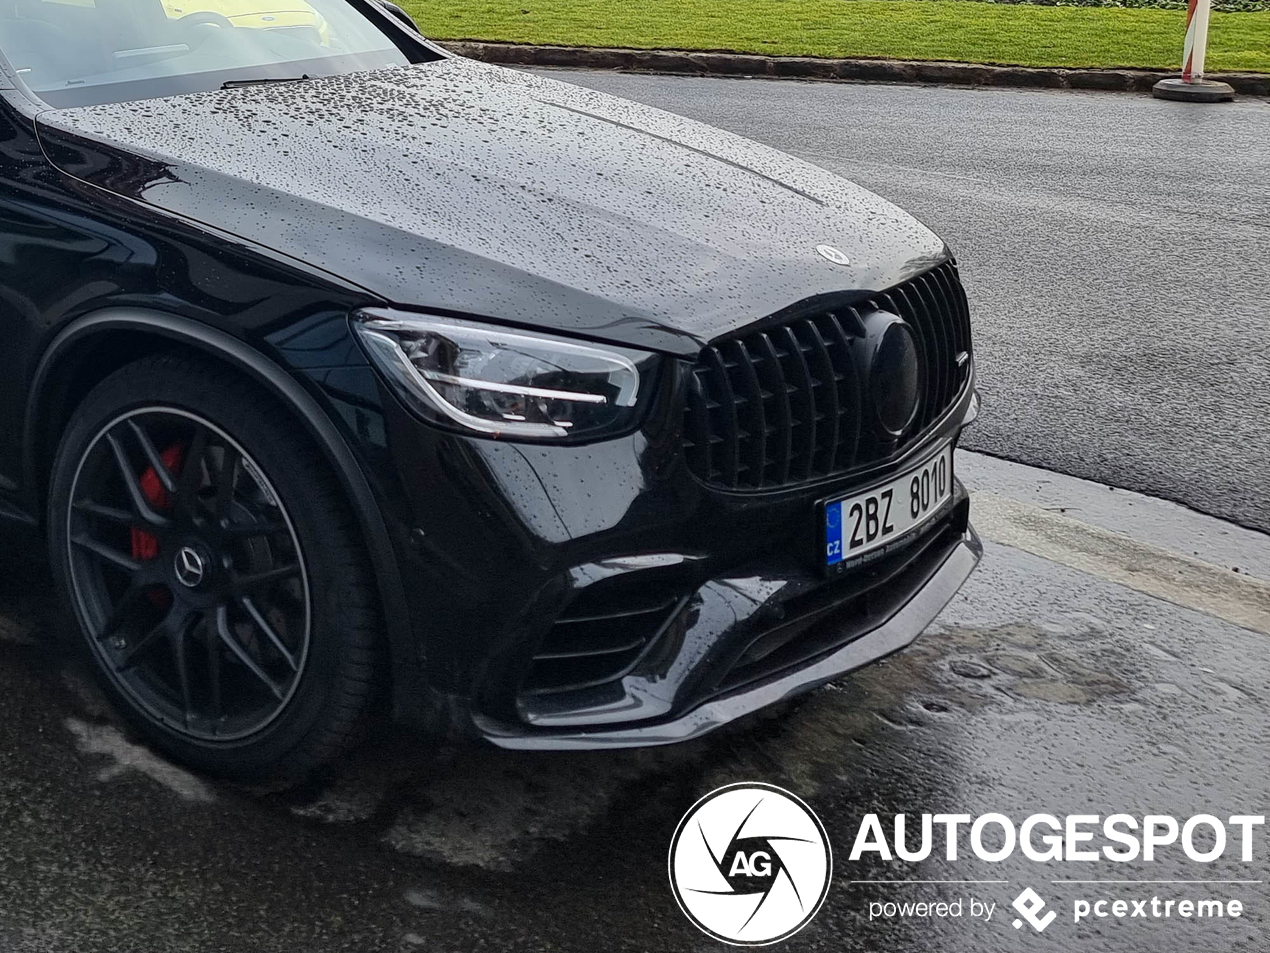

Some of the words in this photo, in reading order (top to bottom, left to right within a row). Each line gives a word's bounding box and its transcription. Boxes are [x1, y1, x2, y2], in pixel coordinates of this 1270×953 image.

[849, 488, 894, 550] 2BZ
[909, 455, 946, 519] 8010
[826, 540, 841, 556] CZ
